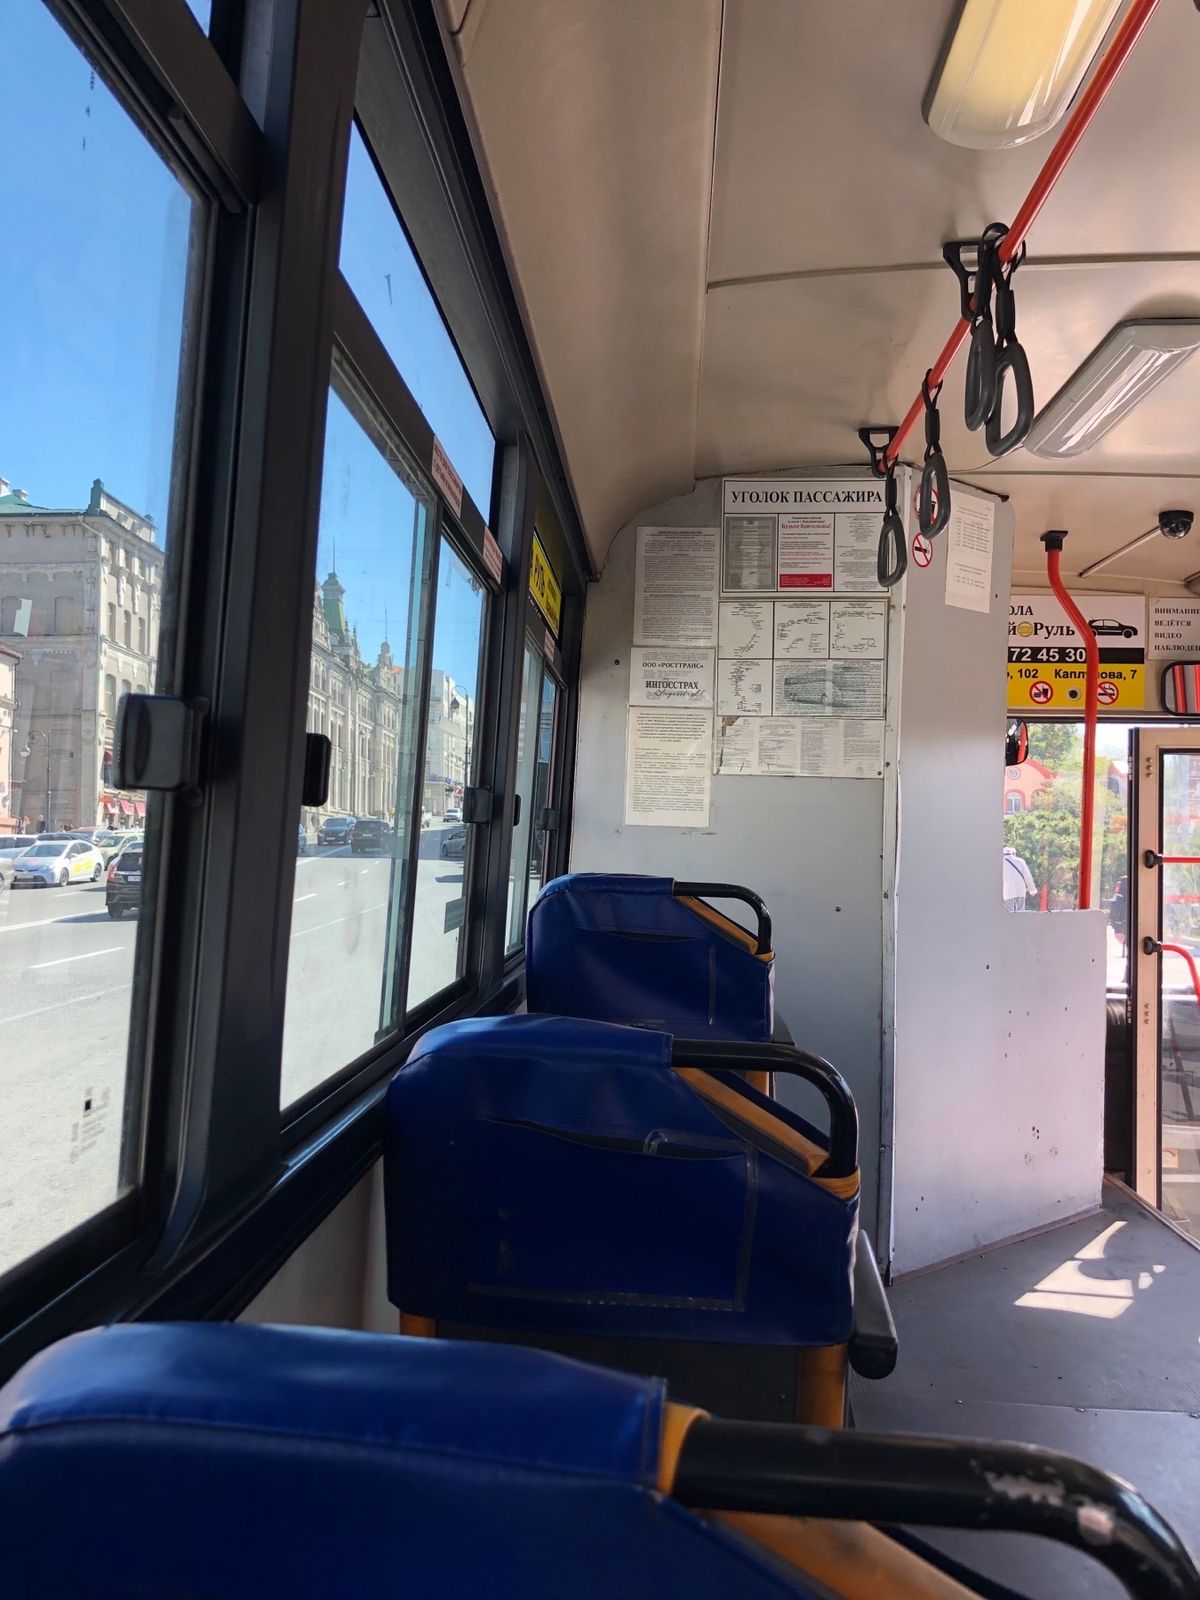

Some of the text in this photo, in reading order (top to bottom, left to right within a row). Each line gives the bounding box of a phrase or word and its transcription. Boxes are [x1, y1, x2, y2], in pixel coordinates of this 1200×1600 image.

[731, 490, 883, 503] УГОЛОК ПАССАЖИРА
[1033, 622, 1076, 640] Руль
[1010, 647, 1087, 662] 72 45 30
[1017, 668, 1039, 679] 102
[1054, 668, 1138, 681] Каплова, 7
[645, 679, 699, 690] ИНГОССТРАХ
